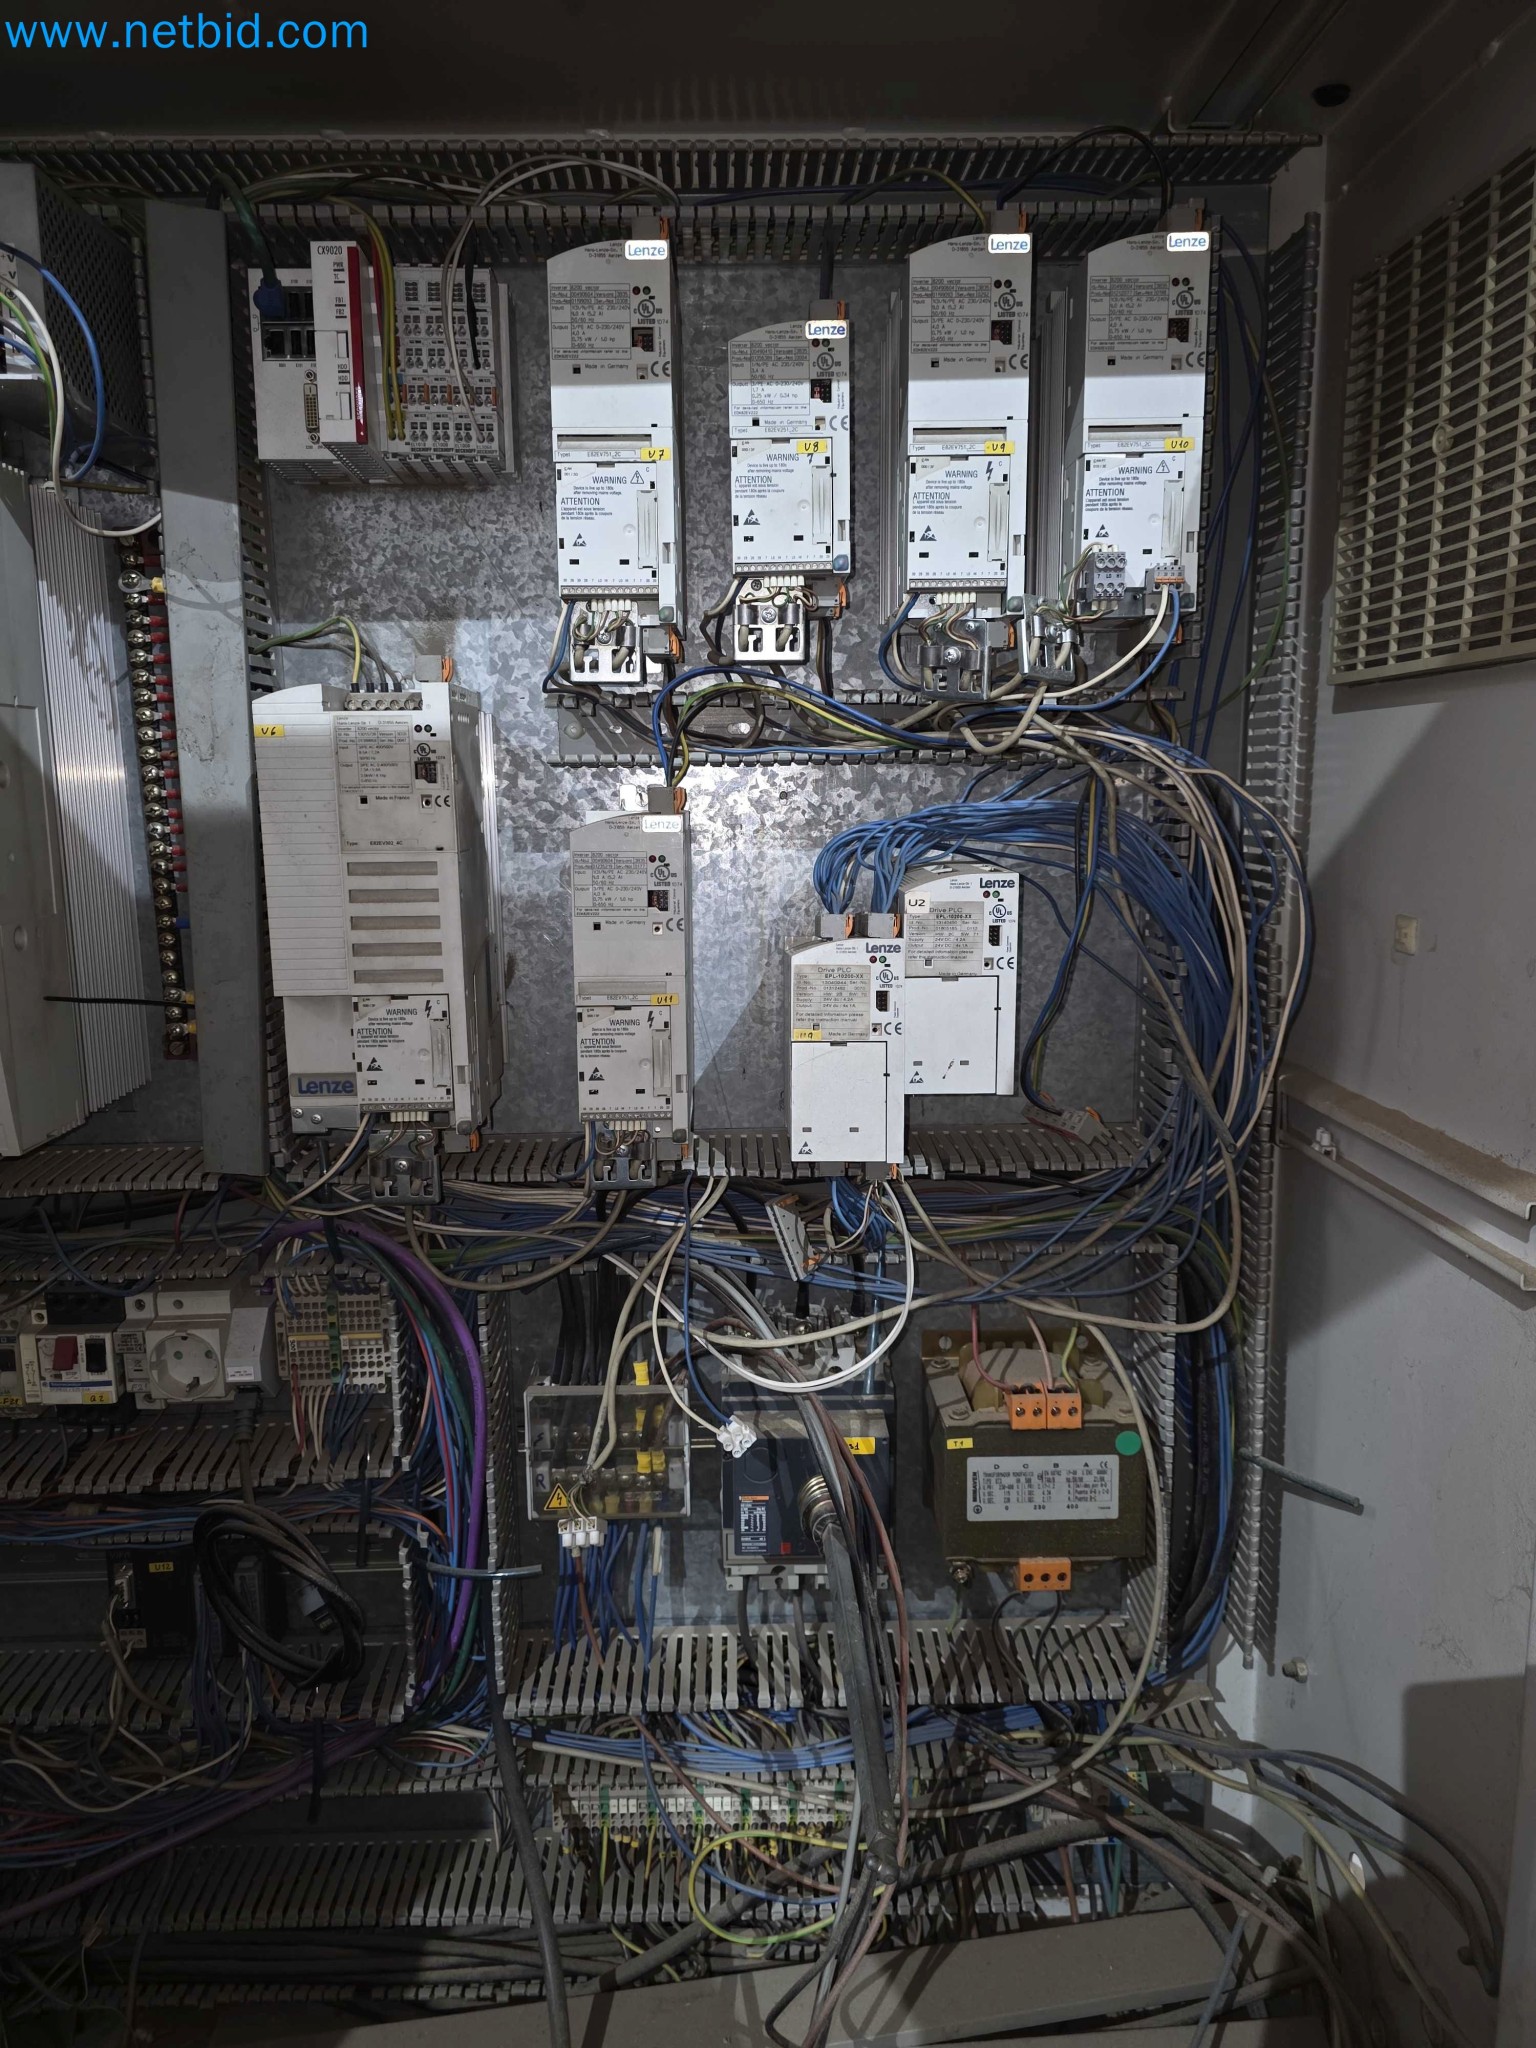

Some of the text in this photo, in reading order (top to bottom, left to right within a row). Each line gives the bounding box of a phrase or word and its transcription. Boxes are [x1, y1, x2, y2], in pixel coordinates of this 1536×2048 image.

[991, 239, 1028, 250] Lenze
[1169, 236, 1206, 247] Lenze
[317, 246, 342, 255] CX9020
[628, 245, 665, 255] Lenze
[808, 324, 845, 335] Lenze
[945, 470, 978, 478] WARNING
[1118, 466, 1152, 474] WARNING
[592, 476, 627, 484] WARNING
[1086, 488, 1124, 496] ATTENTION
[644, 820, 679, 829] Lenze
[980, 878, 1015, 888] Lenze
[866, 942, 901, 953] Lenze
[298, 1078, 354, 1095] Lenze
[536, 1474, 546, 1489] R
